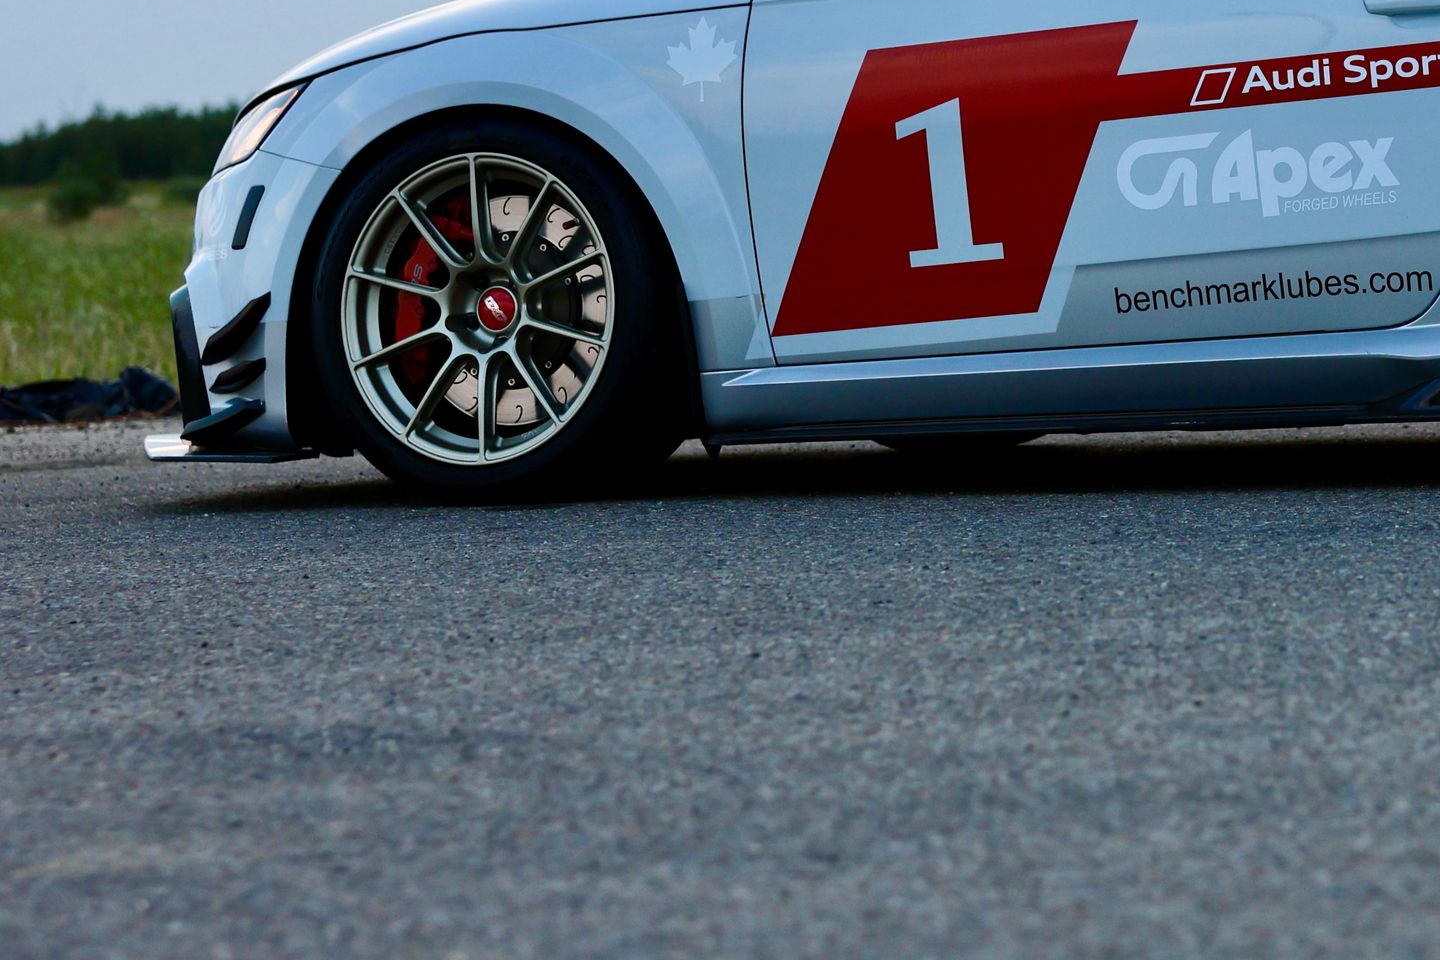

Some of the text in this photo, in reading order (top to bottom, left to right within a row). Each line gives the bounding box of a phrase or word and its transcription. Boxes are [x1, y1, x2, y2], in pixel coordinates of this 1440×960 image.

[1241, 58, 1331, 94] Audi
[895, 97, 1004, 268] 1
[1211, 128, 1400, 218] Apex
[1284, 189, 1397, 213] FORGED WHEELS
[1114, 270, 1433, 314] benchmarklubes.com
